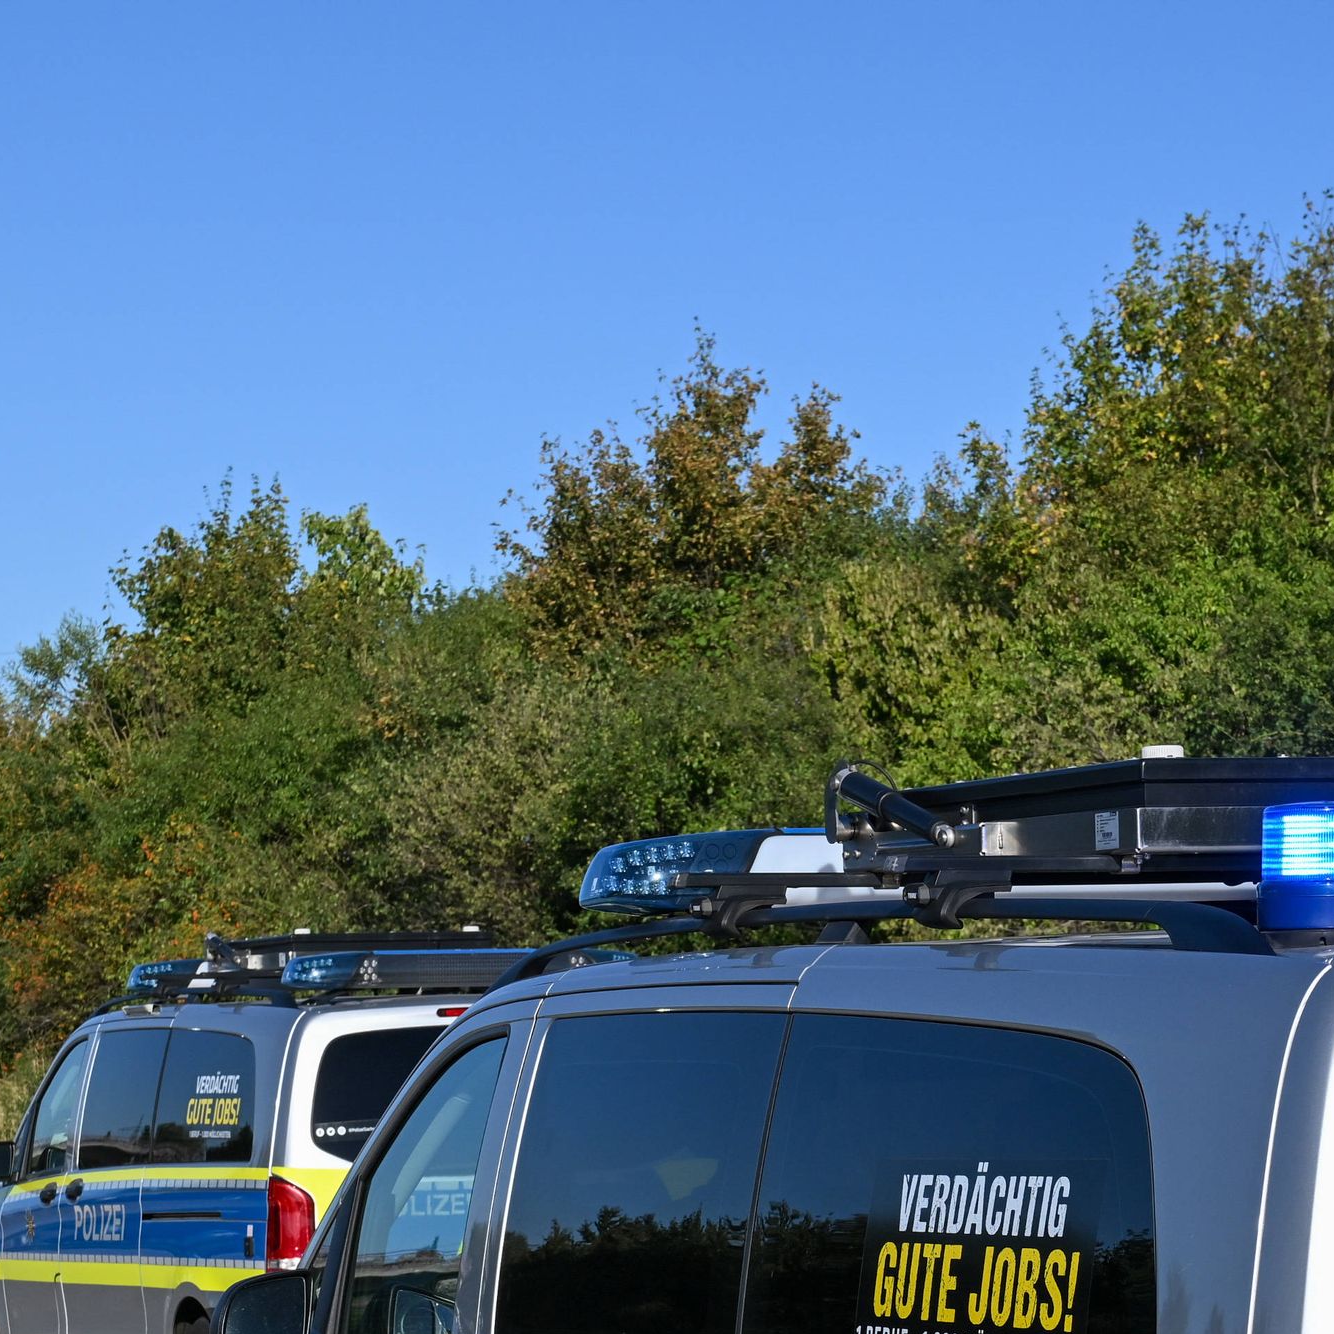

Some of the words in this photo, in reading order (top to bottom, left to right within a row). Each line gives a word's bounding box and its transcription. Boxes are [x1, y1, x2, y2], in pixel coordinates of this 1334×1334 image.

[196, 1071, 240, 1094] VERDÄCHTIG
[186, 1098, 213, 1125] GUTE
[212, 1097, 241, 1127] JOBS!
[898, 1161, 1071, 1238] VERDÄCHTIG
[73, 1204, 125, 1241] POLIZEI
[873, 1241, 963, 1323] GUTE
[968, 1246, 1081, 1333] JOBS!
